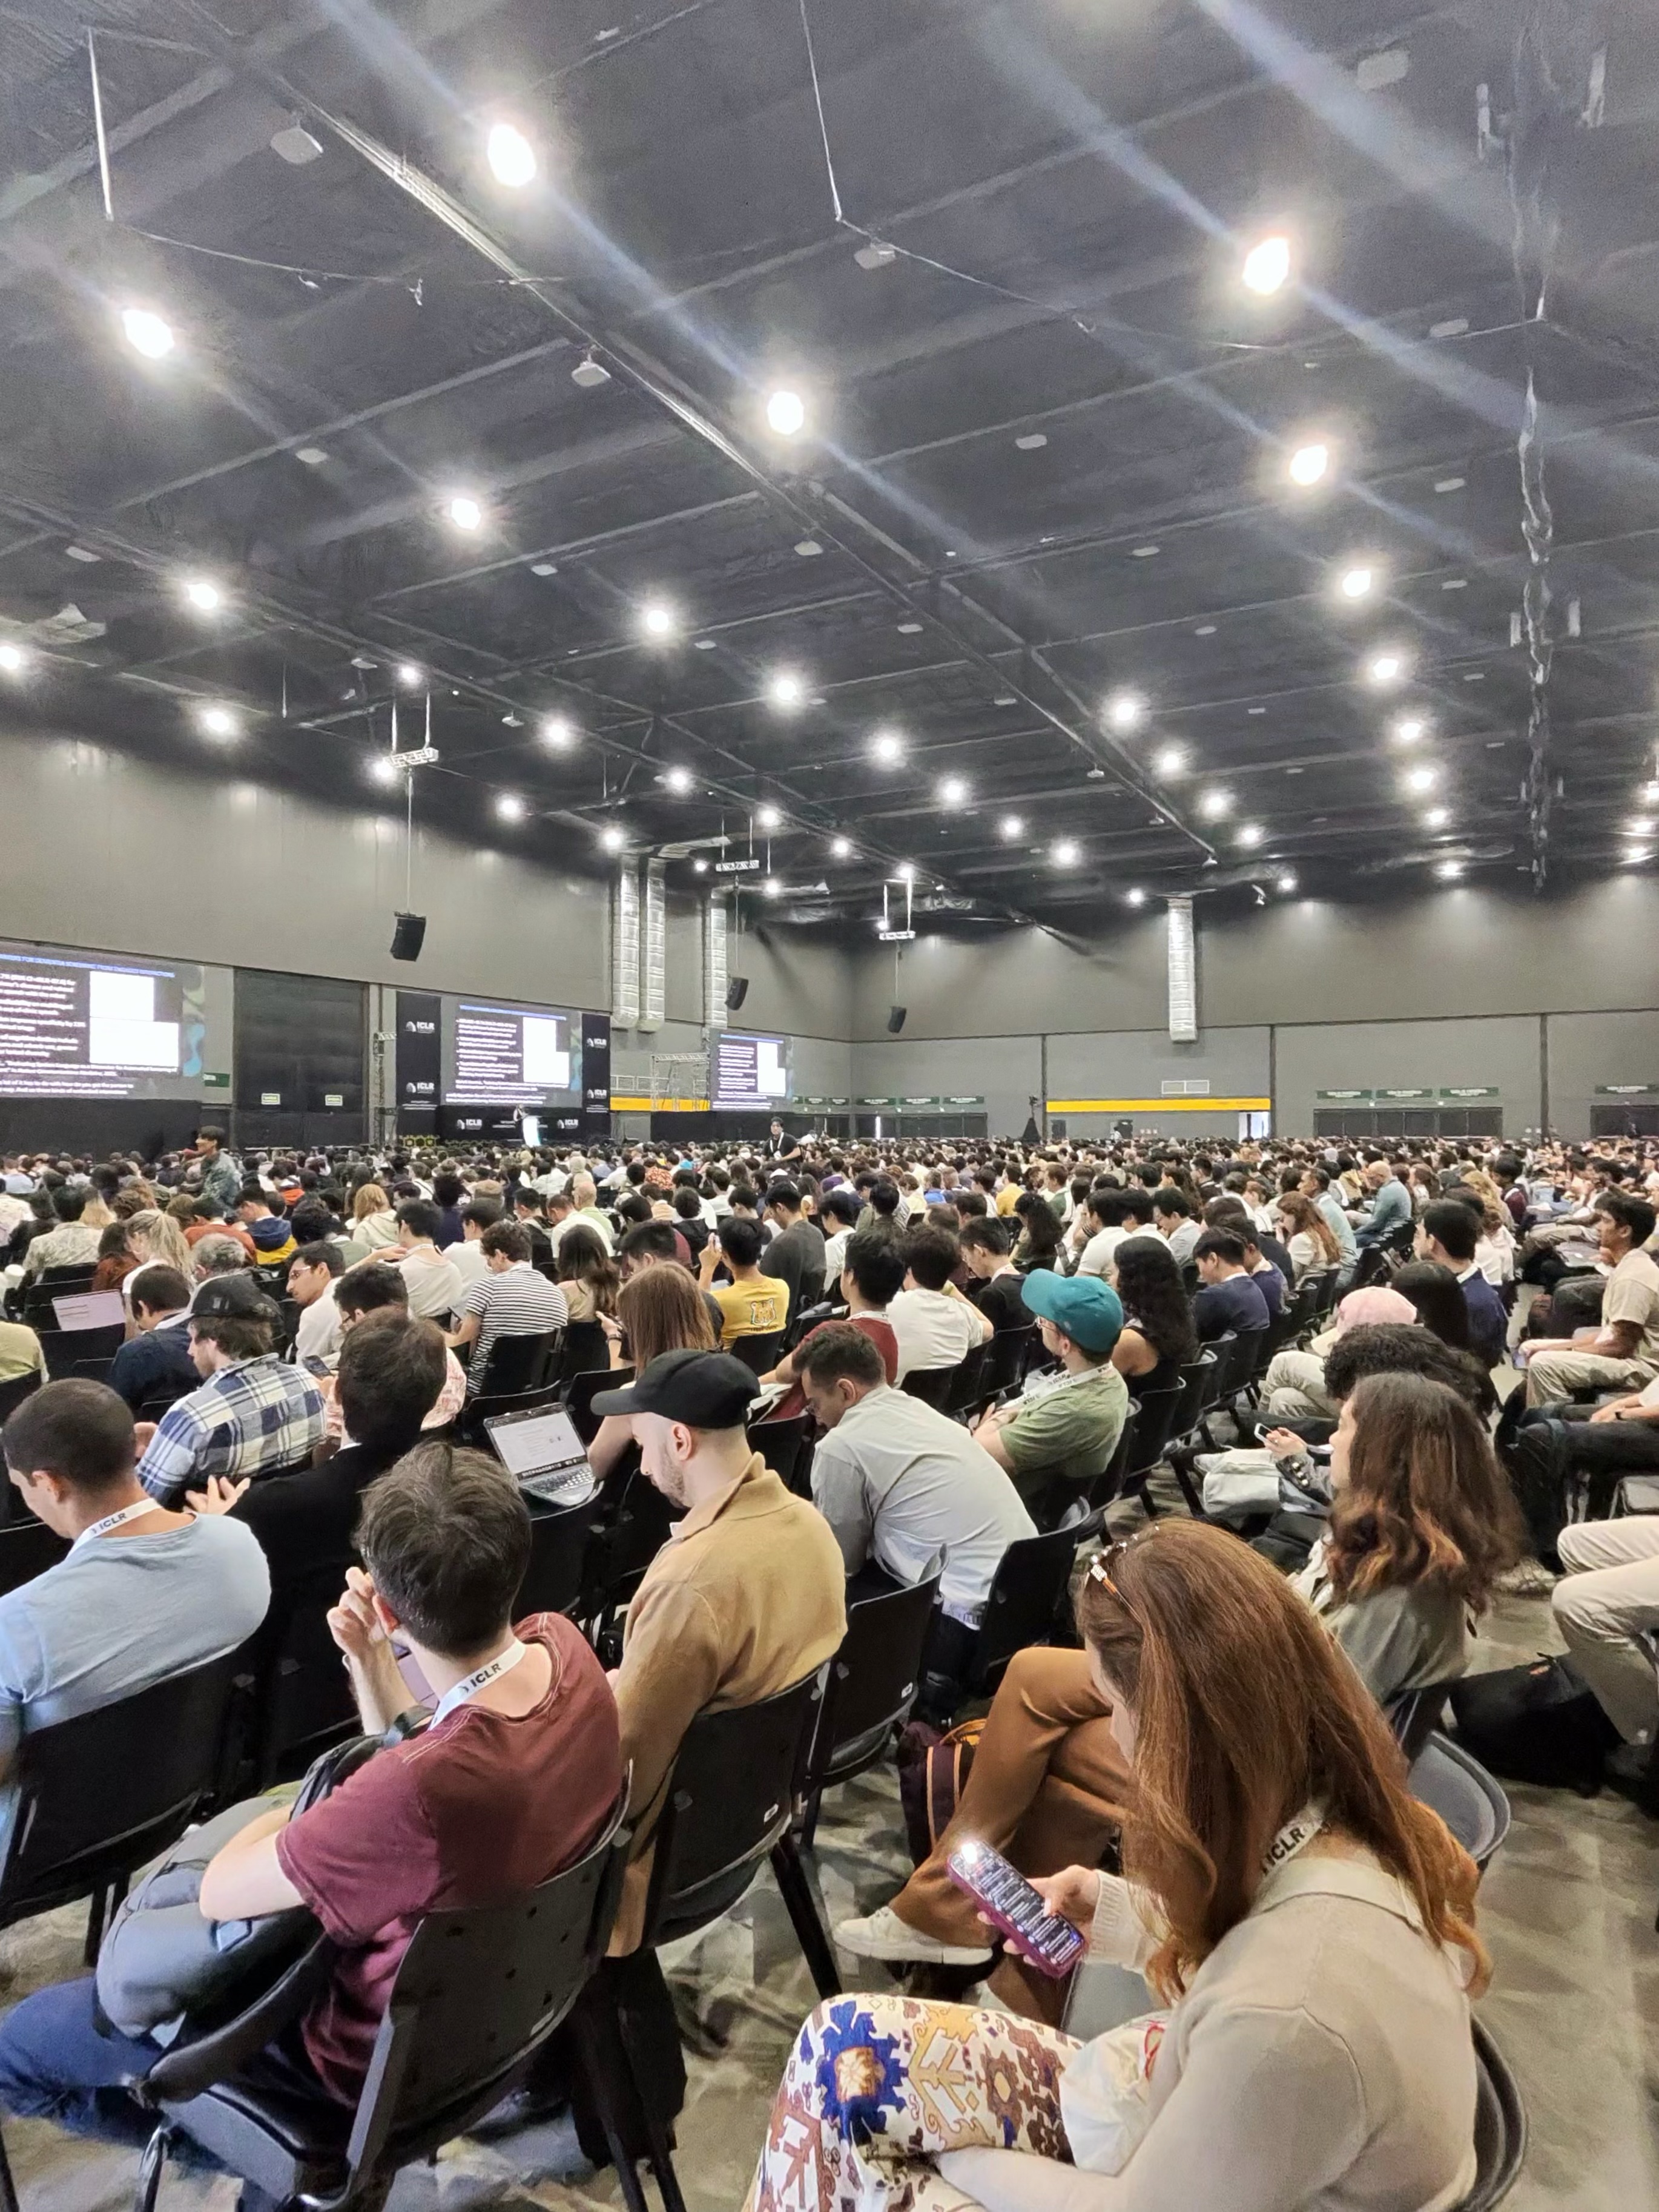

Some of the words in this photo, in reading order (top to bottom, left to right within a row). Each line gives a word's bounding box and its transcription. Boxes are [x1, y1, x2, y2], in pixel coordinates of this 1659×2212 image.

[417, 1021, 434, 1030] ICLR
[99, 1513, 127, 1530] ICLR
[470, 1663, 501, 1687] ICLR
[1266, 1828, 1305, 1867] ICLR
